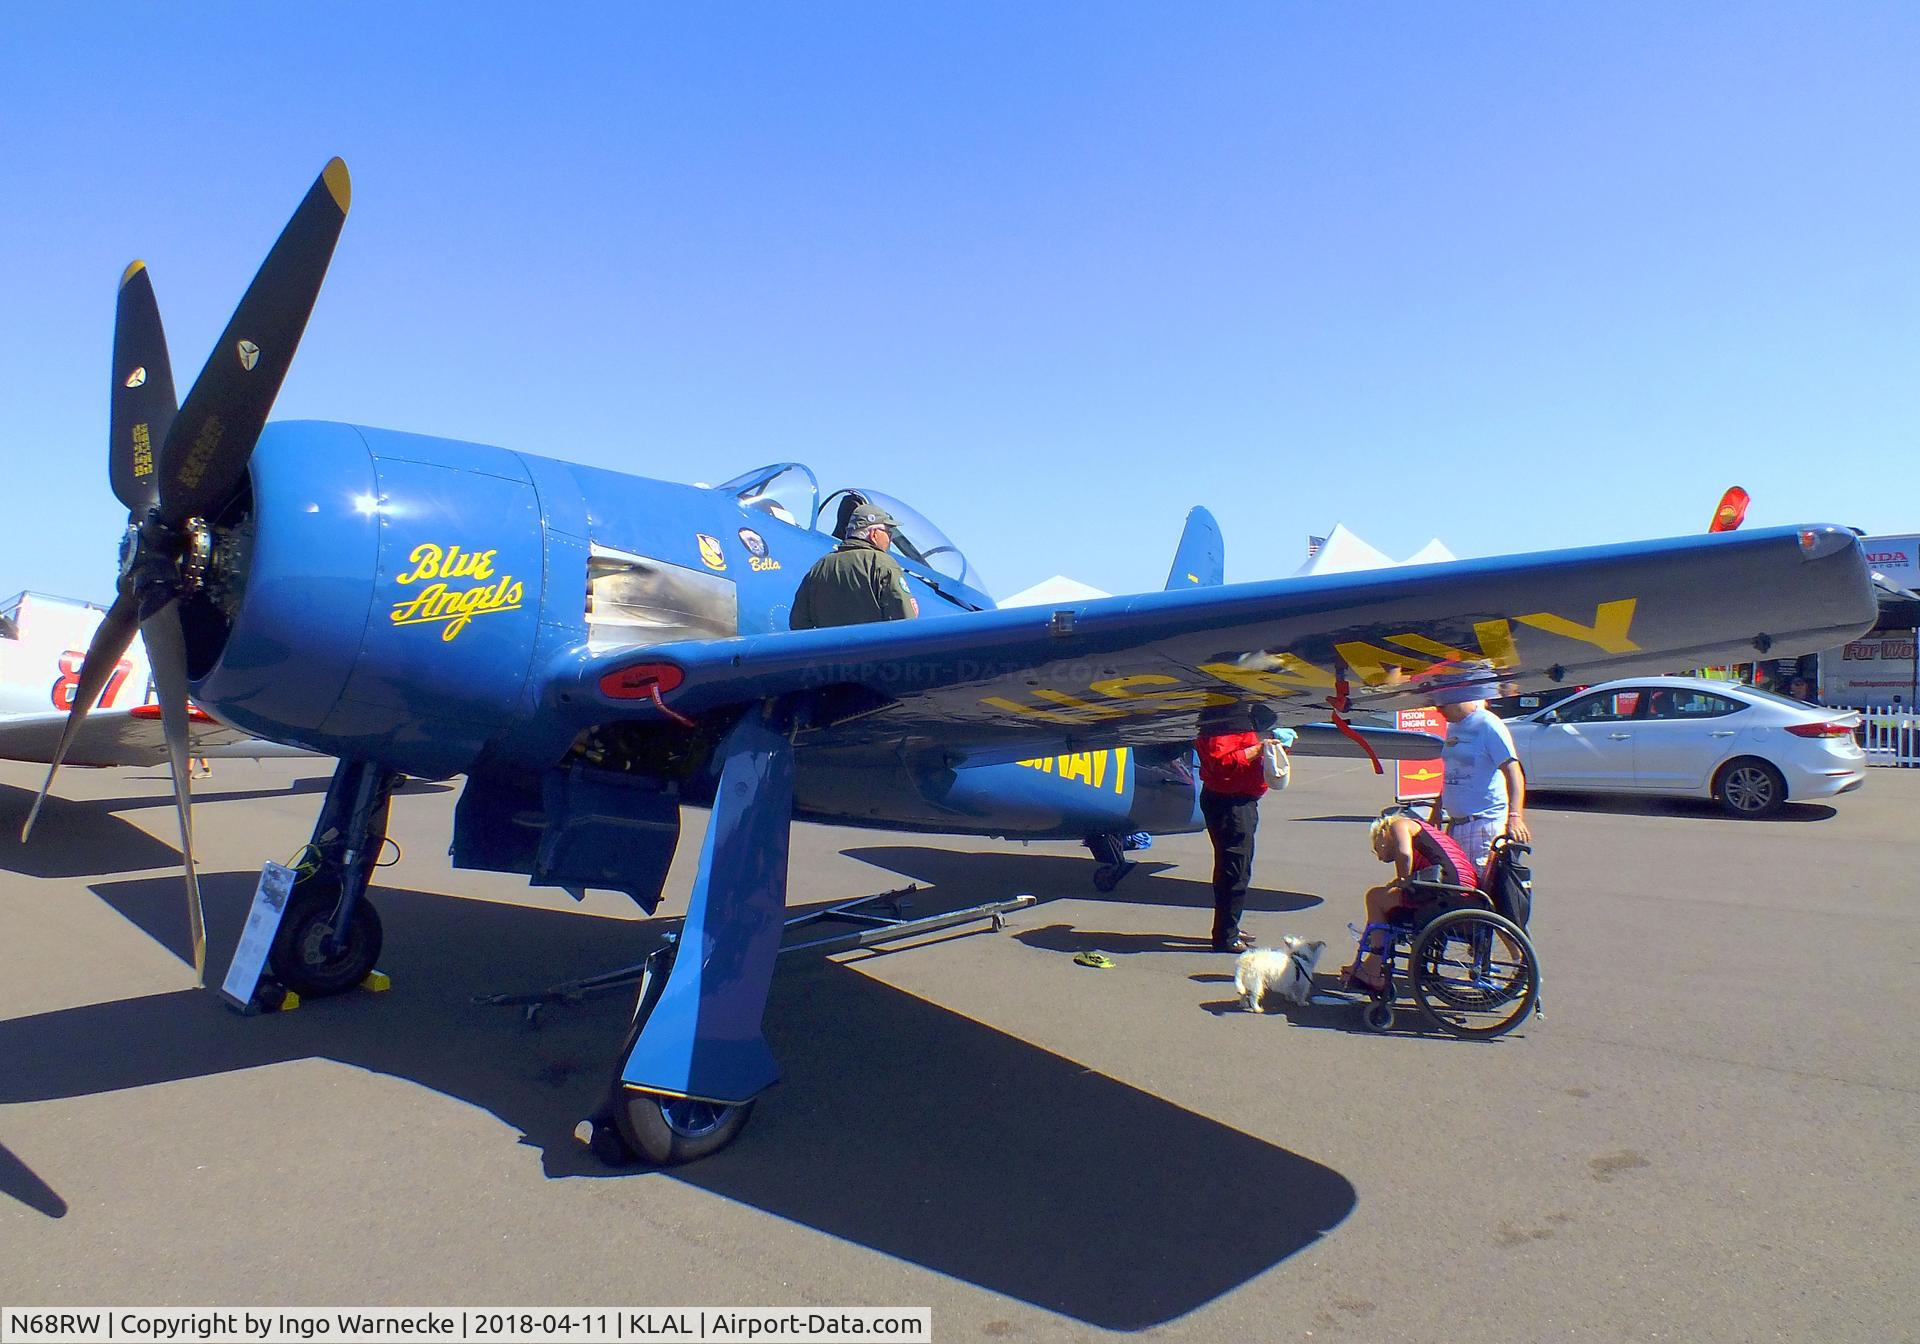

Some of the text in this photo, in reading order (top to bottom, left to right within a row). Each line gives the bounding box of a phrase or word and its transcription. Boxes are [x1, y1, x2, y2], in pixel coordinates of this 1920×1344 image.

[396, 543, 497, 584] Blue
[748, 556, 781, 572] Bella
[390, 575, 523, 641] Angels
[1401, 712, 1425, 720] PISTON
[1401, 720, 1426, 728] ENGINE
